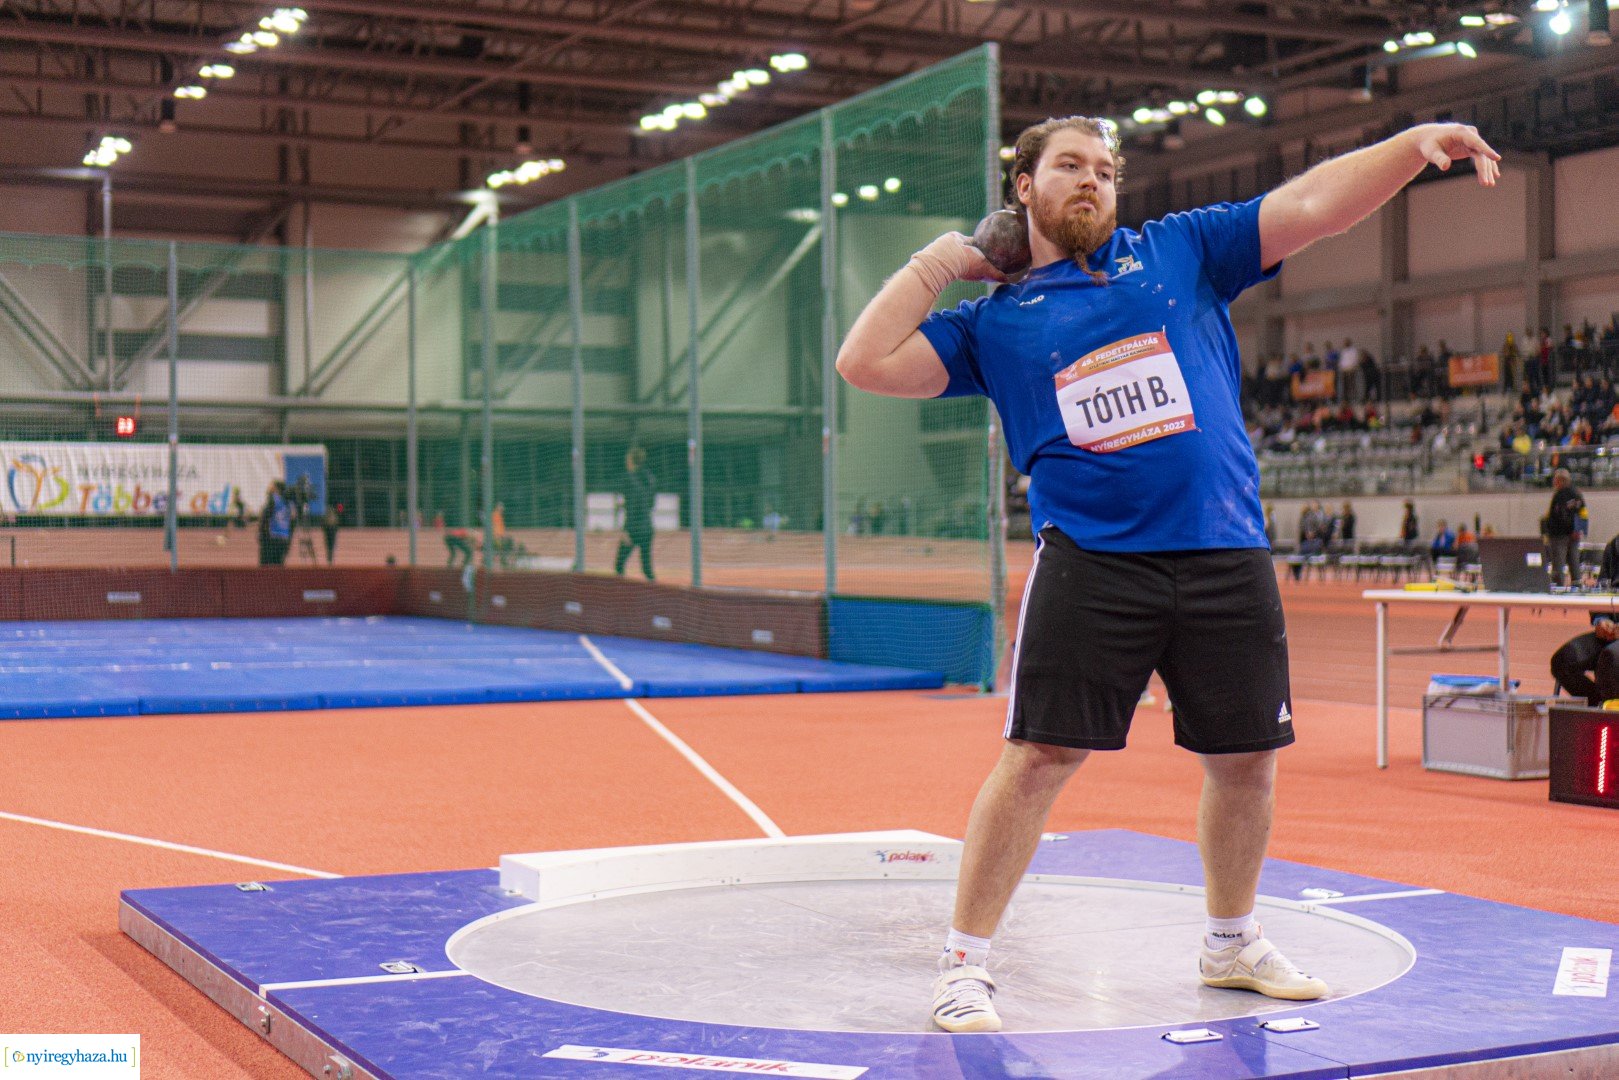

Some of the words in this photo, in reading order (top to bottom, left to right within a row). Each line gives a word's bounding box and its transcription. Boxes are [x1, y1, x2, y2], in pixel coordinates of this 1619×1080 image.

[1081, 358, 1094, 368] 49.
[1095, 336, 1159, 362] FEDETTPÁLYÁS
[1076, 381, 1147, 429] TÓTH
[1149, 376, 1177, 408] B.
[1090, 425, 1162, 452] NYÍREGYHÁZA
[1163, 420, 1186, 433] 2023
[77, 462, 198, 479] NYÍREGYHZA
[621, 1054, 800, 1072] polanik
